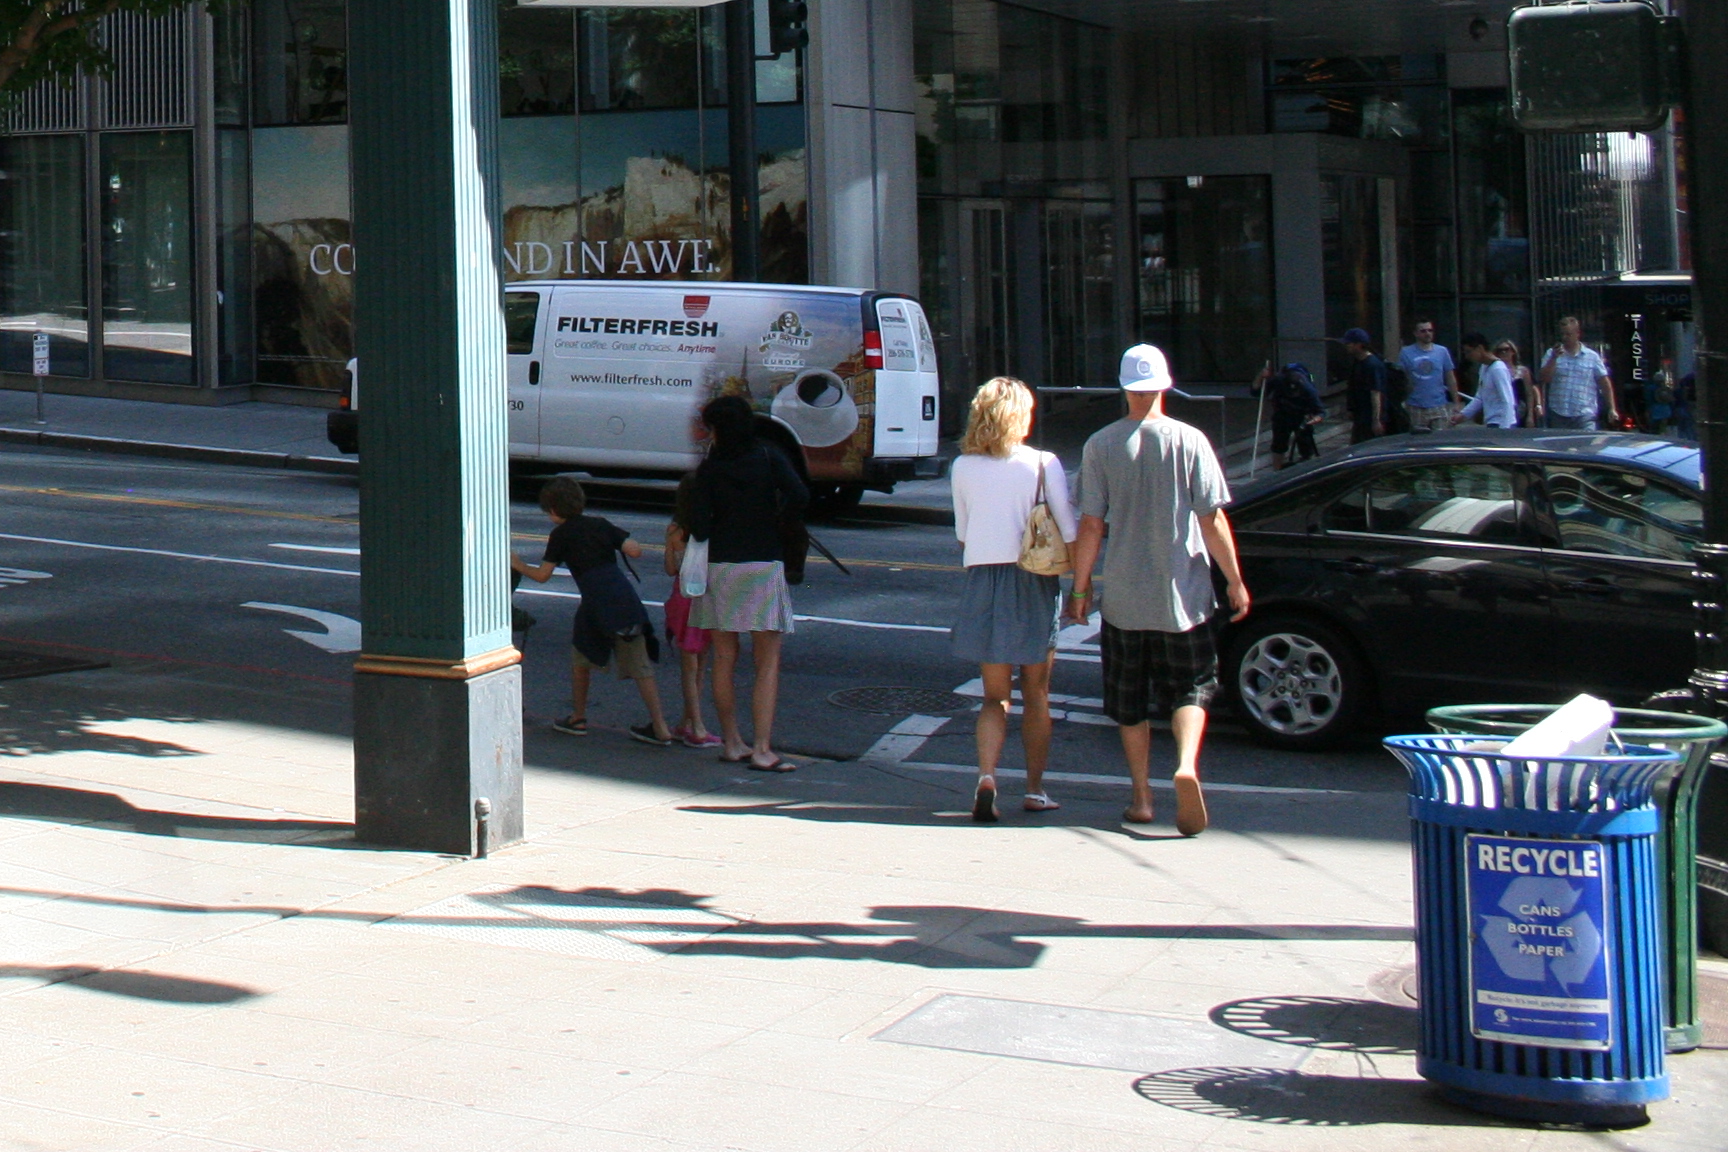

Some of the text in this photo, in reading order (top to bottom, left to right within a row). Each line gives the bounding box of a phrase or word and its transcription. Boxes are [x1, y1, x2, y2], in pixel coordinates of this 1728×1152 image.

[564, 239, 608, 274] IN
[617, 238, 722, 274] AWE.
[557, 316, 719, 337] FILTERFRESH
[1631, 318, 1642, 380] TASTE
[570, 372, 693, 388] www.filterfresh.com
[1478, 844, 1599, 877] RECYCLE
[1518, 903, 1562, 917] CANS
[1507, 922, 1574, 938] BOTTLES
[1518, 943, 1565, 957] PAPER
